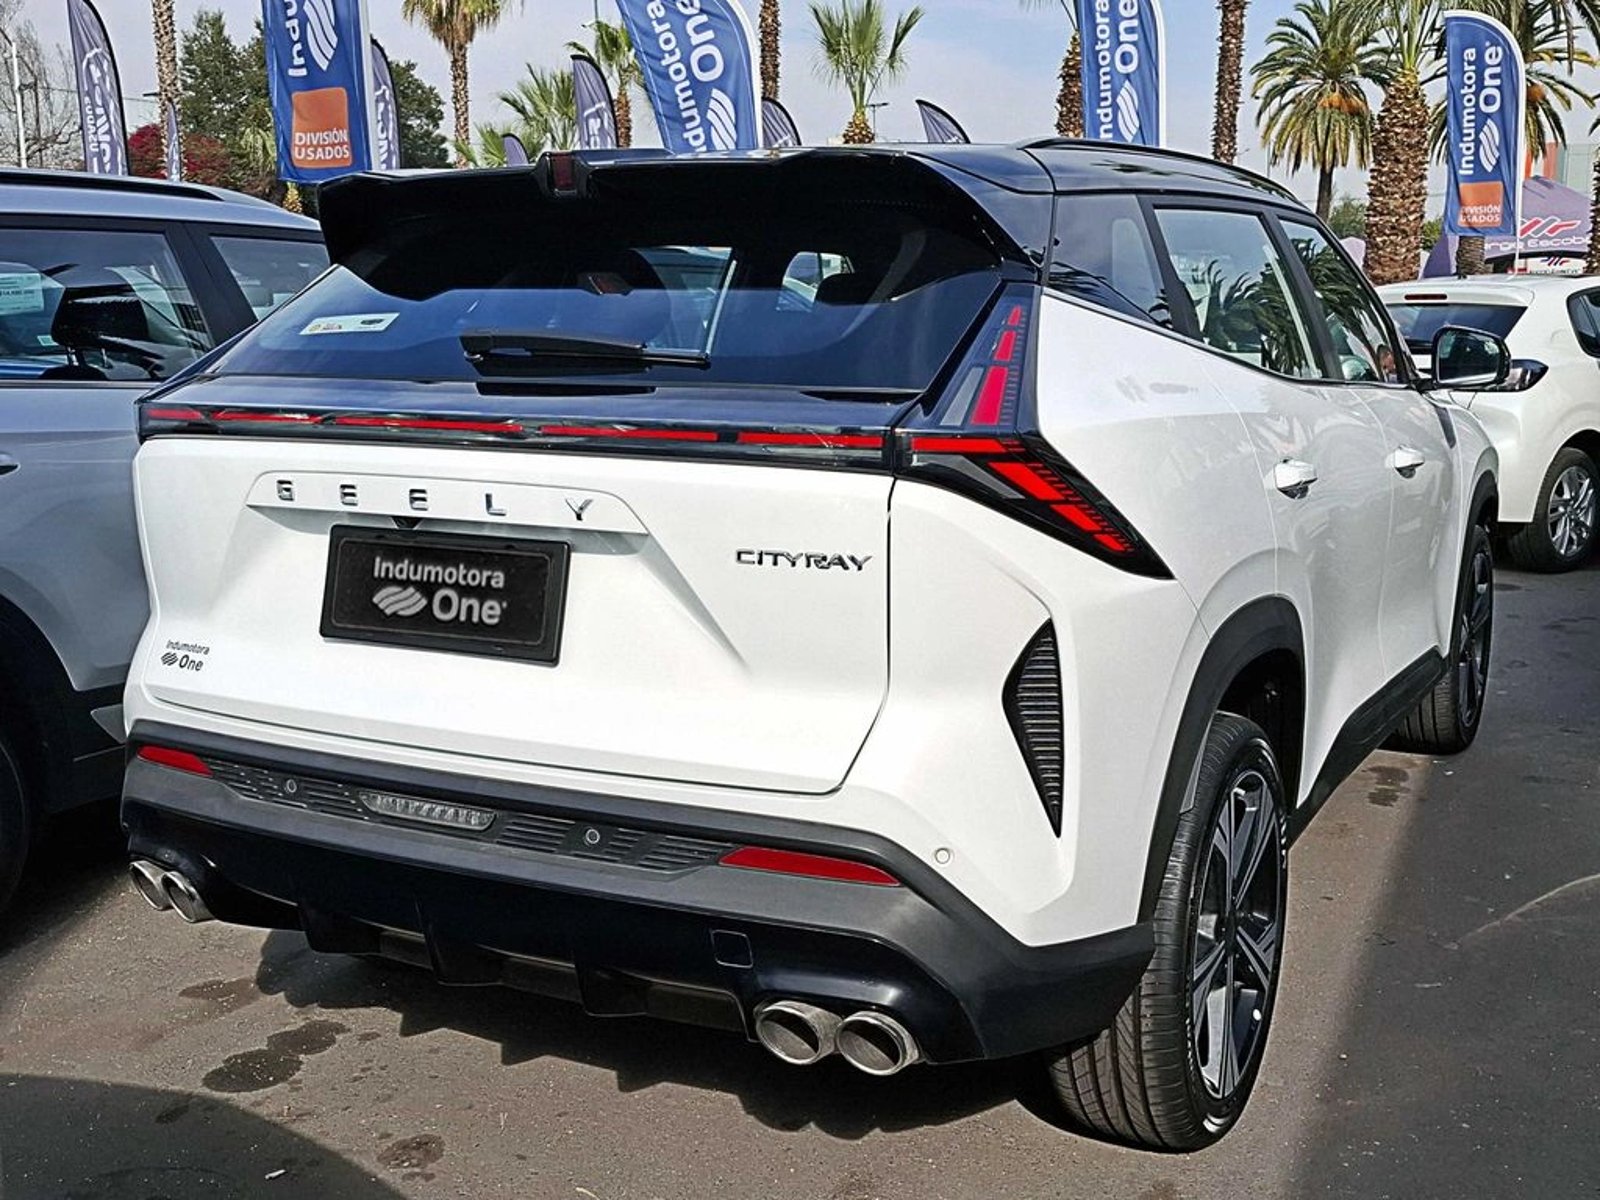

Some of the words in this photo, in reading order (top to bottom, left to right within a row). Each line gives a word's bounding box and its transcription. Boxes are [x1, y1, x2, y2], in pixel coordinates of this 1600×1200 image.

[284, 0, 308, 76] Indu
[675, 0, 724, 82] One
[1114, 0, 1138, 74] One
[646, 0, 707, 152] dumotora
[1095, 0, 1113, 139] ndumotora
[1479, 46, 1503, 114] One
[1458, 47, 1477, 175] Indumotora
[294, 127, 348, 145] DIVISIÓN
[294, 145, 350, 160] USADOS
[1527, 235, 1592, 248] Escob
[276, 480, 593, 520] GEELY
[373, 556, 505, 588] Indumotora
[736, 549, 873, 571] CITYRAY
[432, 588, 502, 625] One
[179, 654, 204, 671] One
